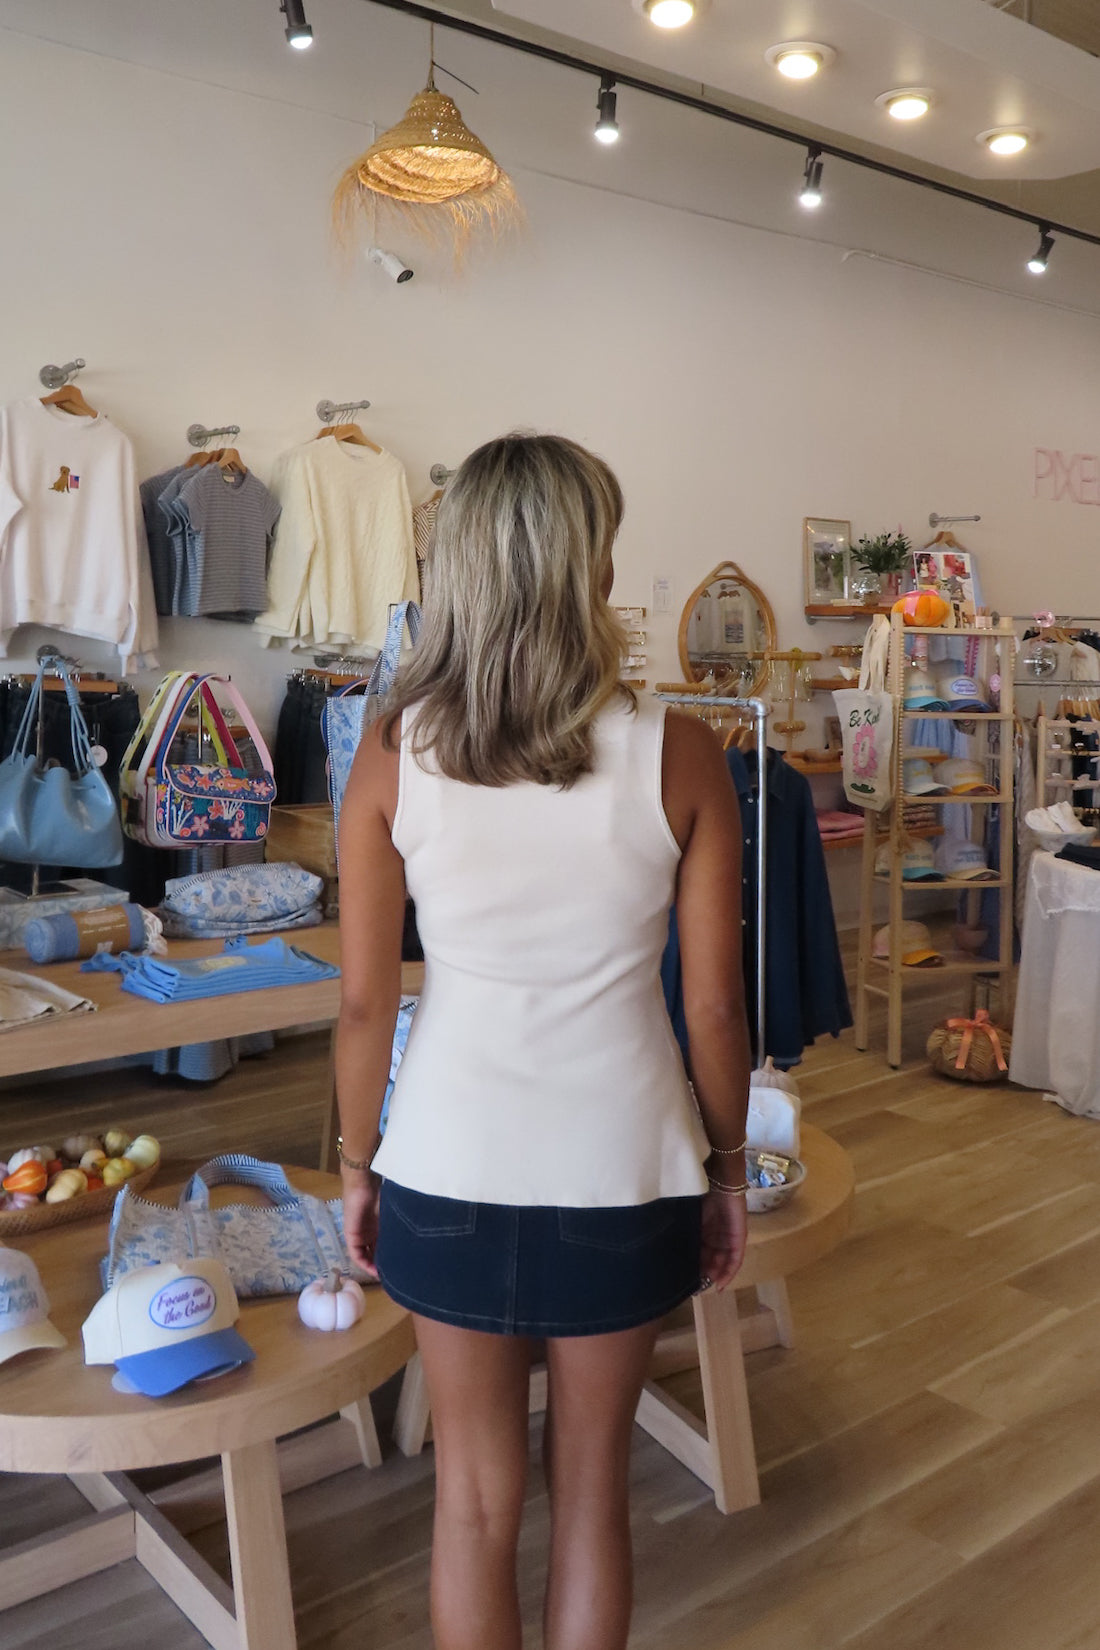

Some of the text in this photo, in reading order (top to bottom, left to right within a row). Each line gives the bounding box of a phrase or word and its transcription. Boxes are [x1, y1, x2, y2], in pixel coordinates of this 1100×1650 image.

[849, 709, 861, 727] Be
[157, 1291, 191, 1311] Focus
[164, 1294, 211, 1324] the Good
